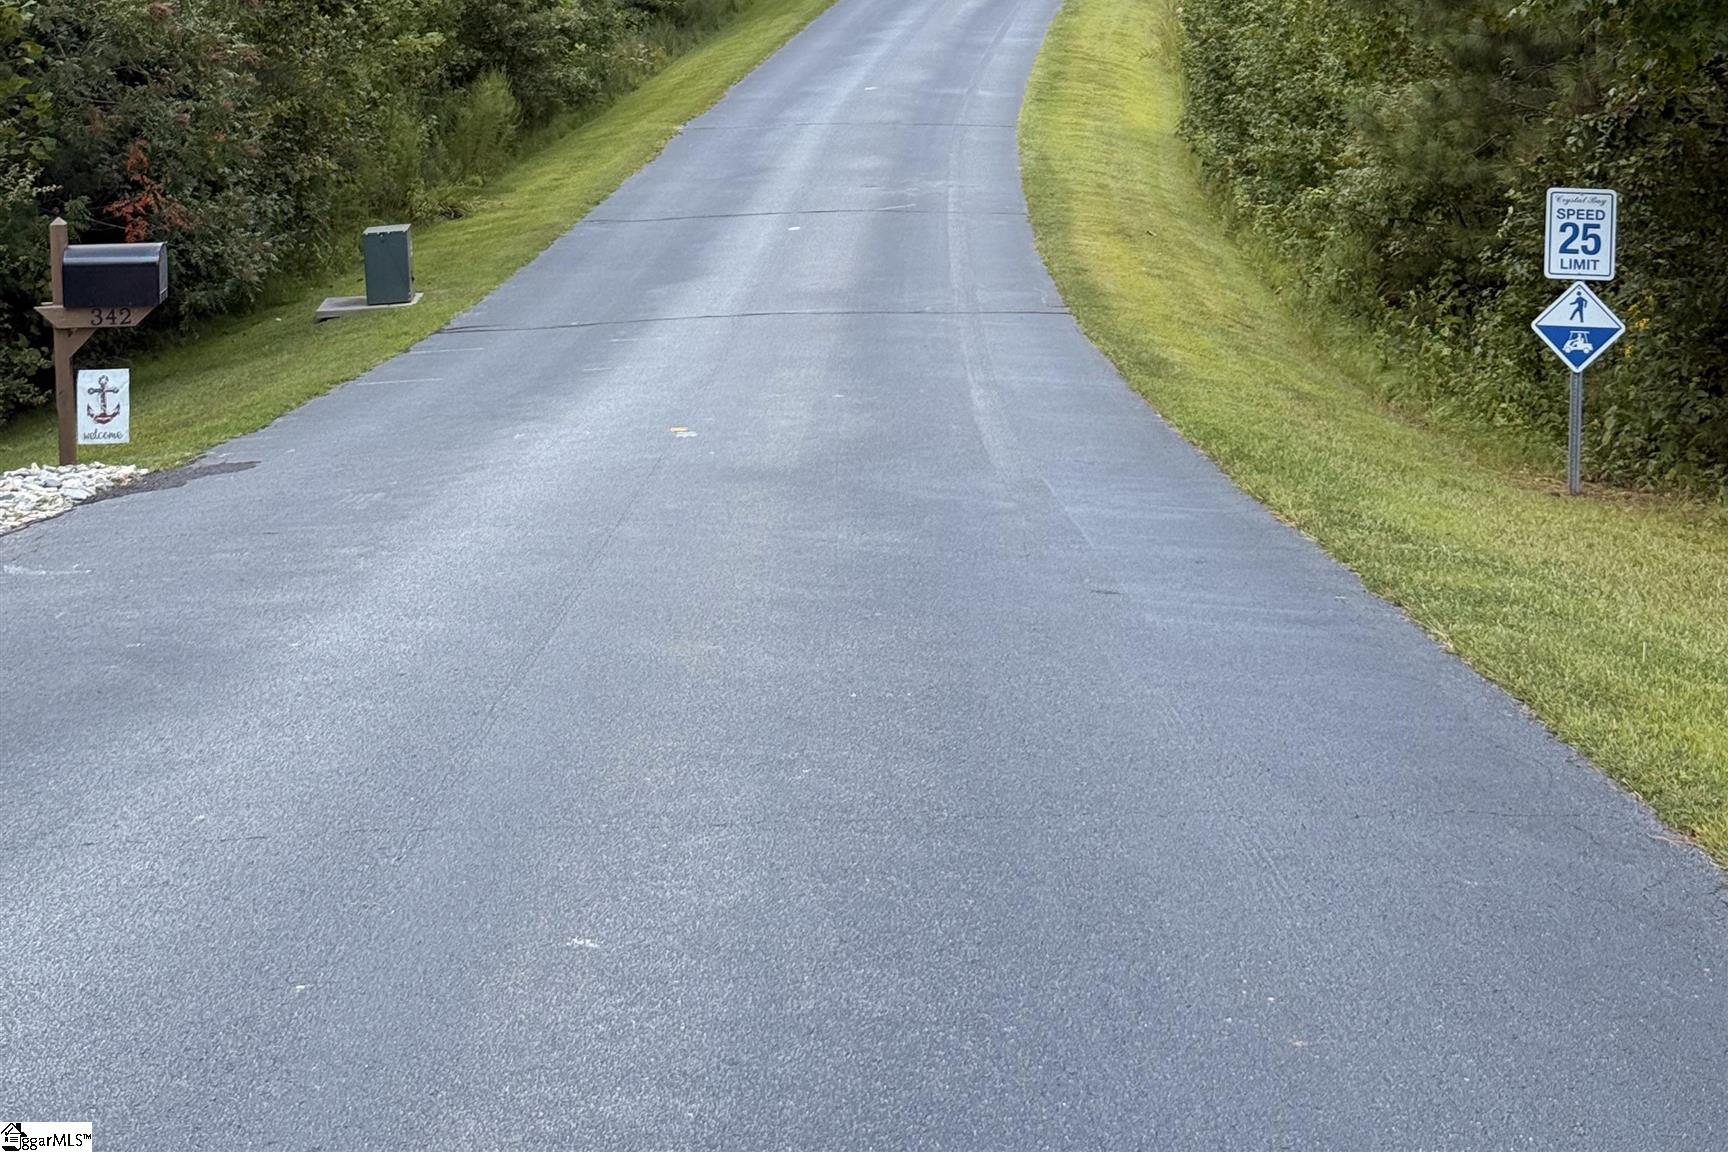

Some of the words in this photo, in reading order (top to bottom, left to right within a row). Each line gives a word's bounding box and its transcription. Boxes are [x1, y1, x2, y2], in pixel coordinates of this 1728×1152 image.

[1555, 195, 1587, 205] Crystal
[1587, 196, 1607, 206] Bay
[1556, 208, 1606, 221] SPEED
[1559, 222, 1602, 256] 25
[1560, 258, 1600, 270] LIMIT
[91, 308, 131, 326] 342
[83, 428, 124, 440] welcome
